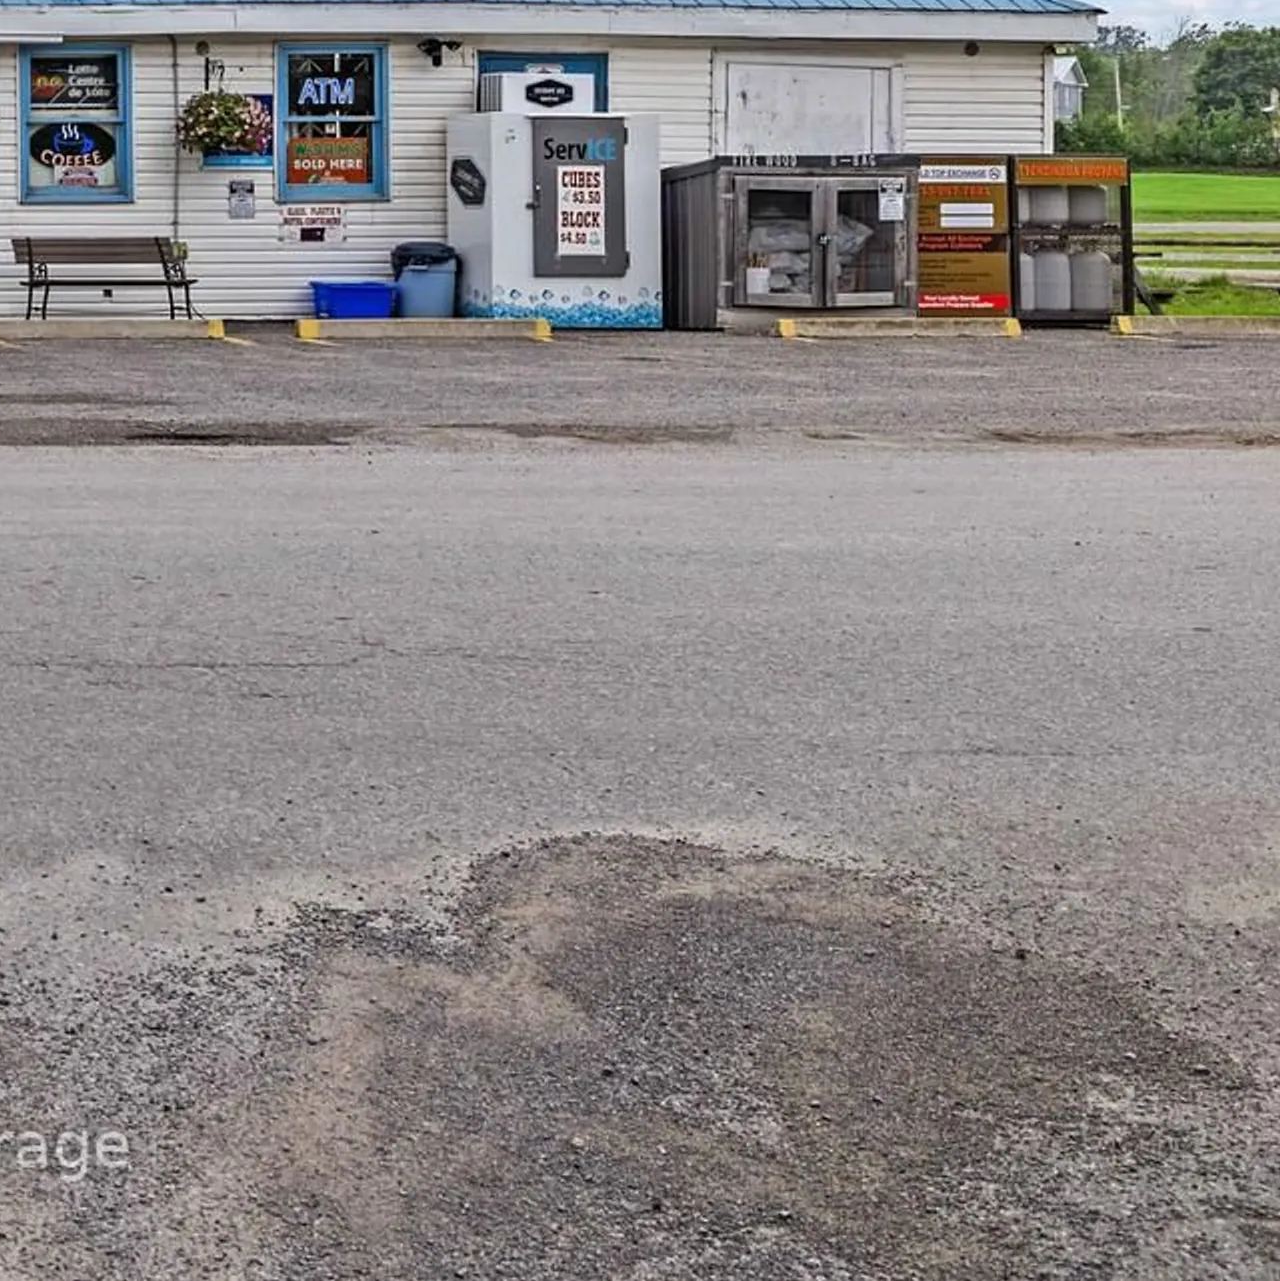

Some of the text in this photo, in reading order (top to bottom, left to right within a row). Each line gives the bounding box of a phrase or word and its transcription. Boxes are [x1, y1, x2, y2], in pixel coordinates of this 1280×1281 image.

[68, 64, 100, 75] Lotto
[68, 75, 105, 86] Centre
[298, 77, 354, 104] ATM
[41, 149, 103, 167] COFFEE
[294, 159, 363, 170] SOLD HERE
[562, 172, 600, 188] CUBES
[572, 191, 600, 204] $3.50
[561, 211, 600, 227] BLOCK
[560, 232, 587, 244] $4.50
